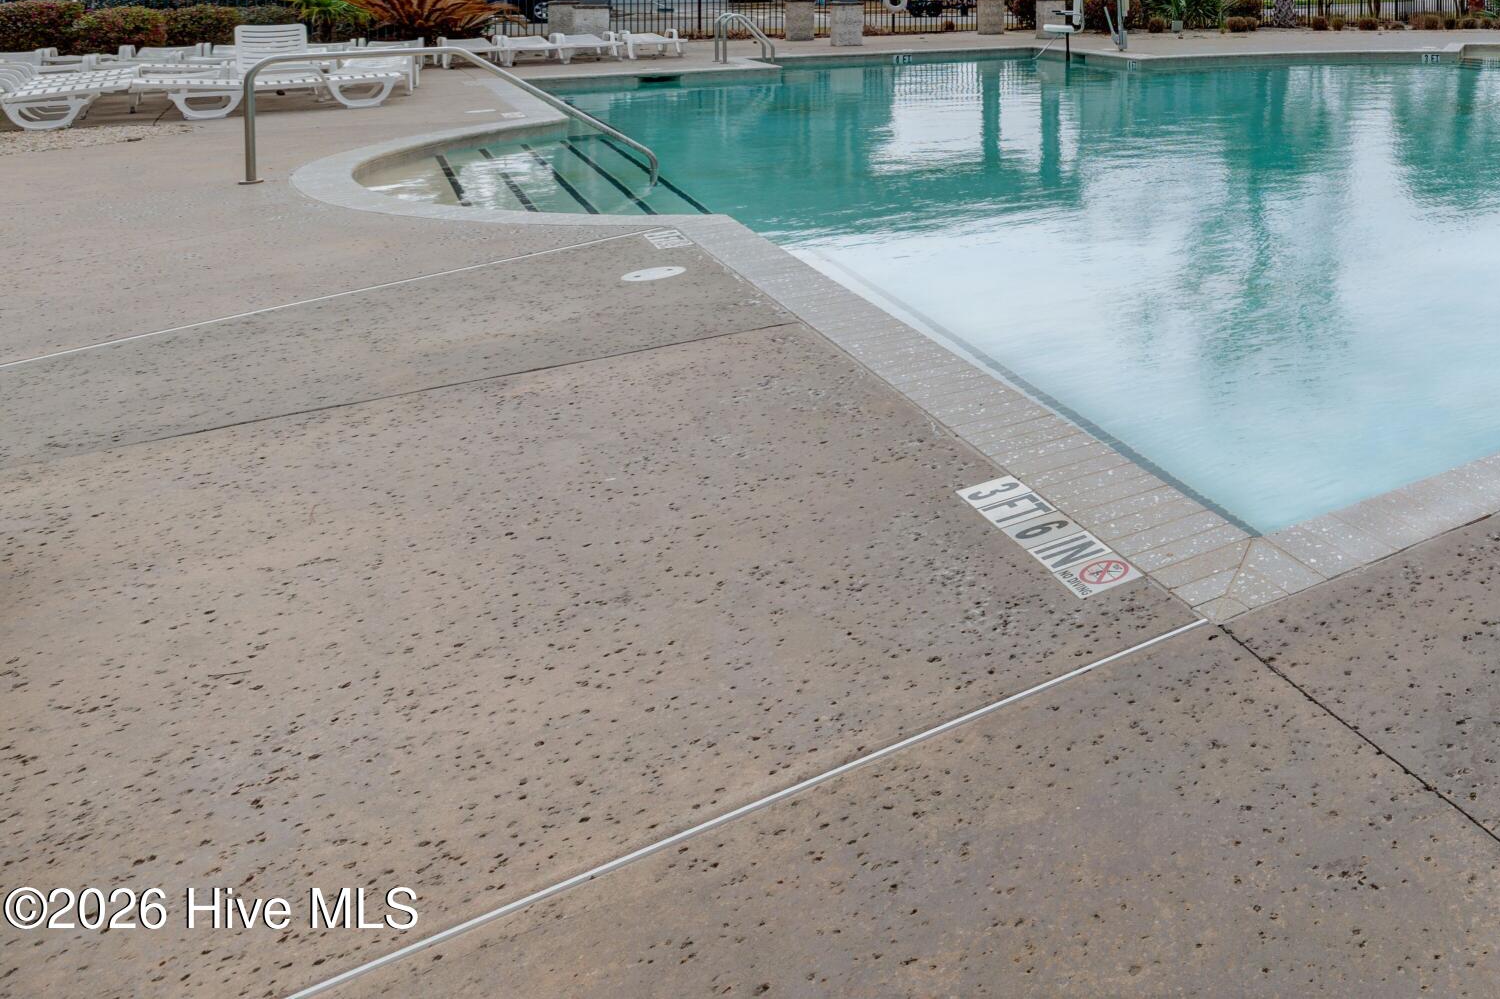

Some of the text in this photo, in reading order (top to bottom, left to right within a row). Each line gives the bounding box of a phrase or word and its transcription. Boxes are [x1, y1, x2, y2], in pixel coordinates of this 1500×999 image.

[967, 482, 1106, 569] 3 FT 6 IN
[1058, 570, 1093, 596] NO DIVING
